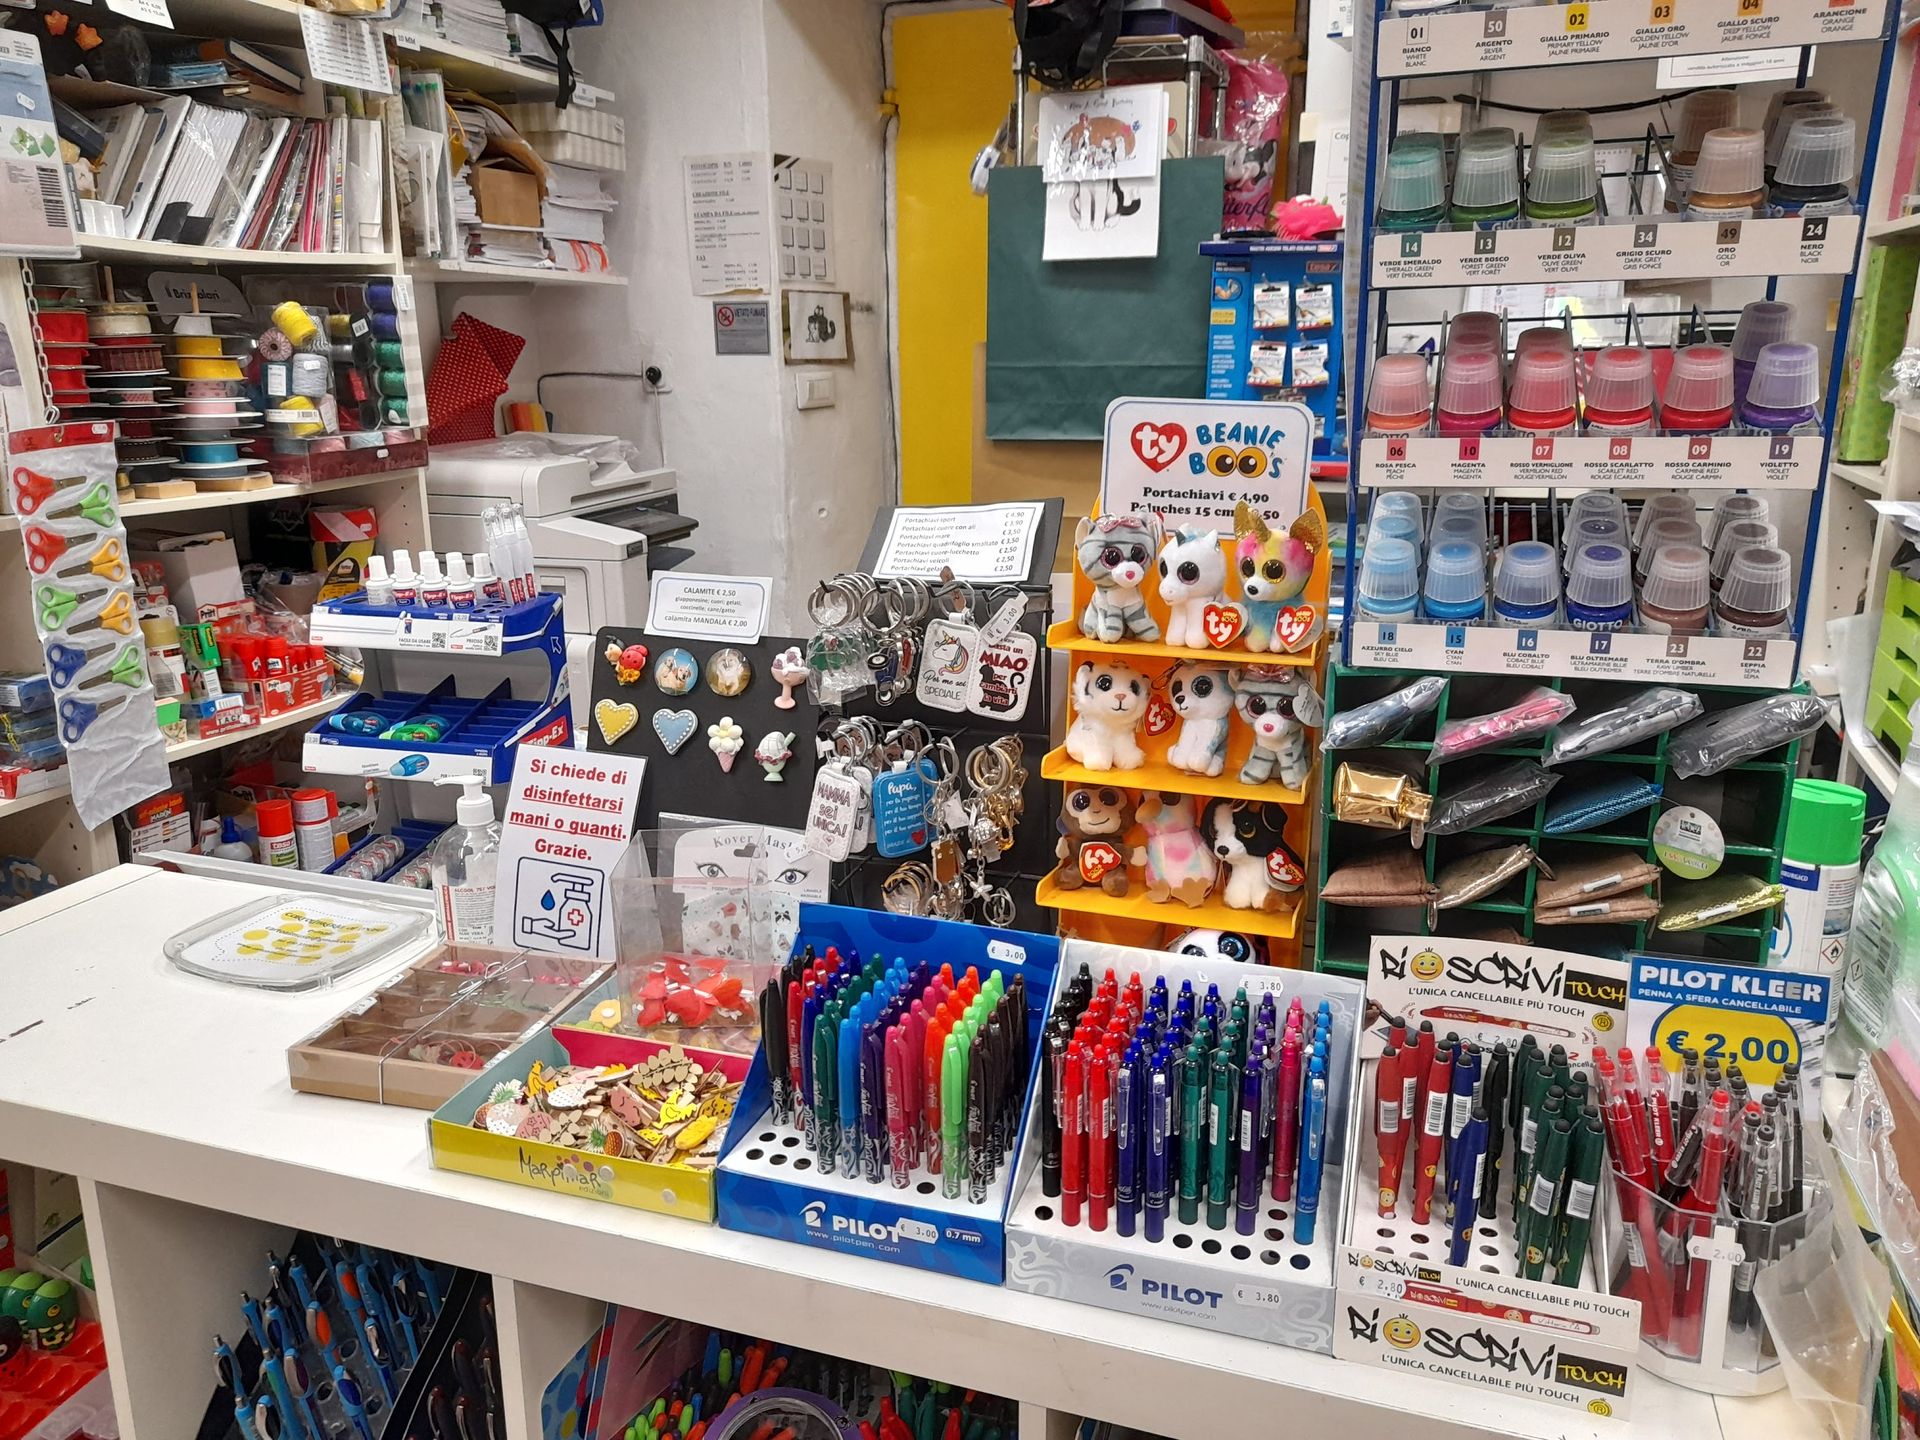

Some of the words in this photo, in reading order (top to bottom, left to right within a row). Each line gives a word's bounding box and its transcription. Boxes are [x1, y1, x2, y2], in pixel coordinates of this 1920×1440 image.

[1654, 6, 1670, 19] 03
[1812, 8, 1867, 19] ARANCIONE
[1569, 13, 1585, 26] 02
[1717, 20, 1748, 29] GIALLO
[1750, 16, 1780, 25] SCURO
[1410, 27, 1424, 39] 01
[1487, 20, 1502, 33] 50
[1635, 27, 1665, 36] GIALLO
[1667, 25, 1686, 33] ORO
[1475, 39, 1513, 48] ARGENTO
[1540, 35, 1569, 44] GIALLO
[1570, 32, 1610, 41] PRIMARIO
[1402, 46, 1432, 55] BIANCO
[1720, 227, 1737, 240] 49
[1805, 223, 1823, 237] 24
[1557, 235, 1572, 247] 12
[1638, 231, 1653, 243] 34
[1405, 242, 1418, 253] 14
[1479, 239, 1493, 250] 13
[1718, 246, 1736, 254] ORO
[1800, 243, 1824, 251] NERO
[1537, 254, 1561, 262] VERDE
[1563, 252, 1586, 260] OLIVA
[1615, 250, 1643, 258] GRIGIO
[1645, 248, 1672, 256] SCURO
[1403, 257, 1442, 266] SMERALDO
[1459, 257, 1483, 265] VERDE
[1485, 255, 1510, 263] BOSCO
[1195, 421, 1286, 449] BEANIE
[1135, 424, 1181, 465] ty
[1535, 446, 1550, 456] 07
[1612, 445, 1628, 456] 08
[1691, 445, 1708, 456] 09
[1775, 444, 1789, 455] 19
[1389, 446, 1403, 457] 06
[1463, 446, 1477, 457] 10
[1142, 486, 1225, 502] Portachiavi
[1228, 493, 1237, 501] €
[1194, 506, 1211, 518] 15
[1213, 509, 1235, 518] cm
[999, 564, 1014, 573] 2,50
[683, 587, 716, 597] CALAMITE
[722, 589, 737, 598] 2,50
[664, 615, 692, 624] calamita
[693, 616, 727, 627] MANDALA
[733, 619, 748, 629] 2,00
[1205, 610, 1233, 643] ty
[1278, 612, 1306, 643] ty
[1571, 618, 1624, 632] GIOTTO
[1382, 632, 1394, 642] 18
[1450, 634, 1462, 644] 15
[1521, 637, 1534, 647] 16
[1361, 645, 1393, 653] AZZURRO
[1594, 640, 1607, 650] 17
[1670, 644, 1684, 654] 23
[1747, 647, 1762, 657] 22
[978, 649, 1028, 672] MIAO
[1586, 655, 1629, 663] OLTREMARE
[993, 672, 1008, 681] per
[923, 685, 961, 701] SPECIALE
[530, 758, 546, 774] Si
[550, 762, 606, 784] chiede
[611, 769, 628, 785] di
[523, 784, 624, 812] disinfettarsi
[816, 781, 851, 808] MAMMA
[510, 810, 550, 828] mani
[554, 818, 564, 829] o
[569, 819, 627, 842] guanti.
[812, 814, 849, 838] UNICA!
[713, 833, 754, 850] Kover
[534, 837, 592, 861] Grazie.
[1004, 949, 1025, 961] 3.00
[1259, 981, 1282, 992] 3.80
[1638, 964, 1728, 992] PILOT
[1730, 975, 1823, 1004] KLEER
[1566, 979, 1627, 1005] TOUCH
[1408, 986, 1448, 999] L'UNICA
[1450, 989, 1524, 1008] CANCELLABILE
[1526, 995, 1544, 1010] PIÙ
[1546, 1002, 1586, 1018] TOUCH
[1637, 987, 1673, 1000] PENNA
[1674, 992, 1684, 1001] A
[1685, 993, 1720, 1006] SFERA
[1721, 997, 1803, 1015] CANCELLABILE
[1495, 1034, 1518, 1049] 2.80
[1666, 1029, 1691, 1055] €
[1702, 1032, 1790, 1065] 2,00
[832, 1214, 901, 1244] PILOT
[915, 1226, 937, 1240] 3.00
[805, 1229, 901, 1255] www.pilotpen.com
[945, 1229, 960, 1241] 0.7
[961, 1233, 981, 1244] mm
[1713, 1248, 1743, 1264] 2.00
[1377, 1278, 1404, 1294] 2.80
[1141, 1278, 1224, 1309] PILOT
[1255, 1291, 1280, 1304] 3.80
[1455, 1276, 1496, 1294] L'UNICA
[1497, 1284, 1571, 1308] CANCELLABILE
[1572, 1297, 1591, 1312] PIÙ
[1592, 1303, 1631, 1321] TOUCH
[1140, 1299, 1218, 1322] www.pilotpen.com
[1381, 1352, 1427, 1372] L'UNICA
[1428, 1361, 1513, 1392] CANCELLABILE
[1514, 1377, 1535, 1395] PIÙ
[1536, 1384, 1581, 1406] TOUCH
[1556, 1361, 1626, 1392] TOUCH
